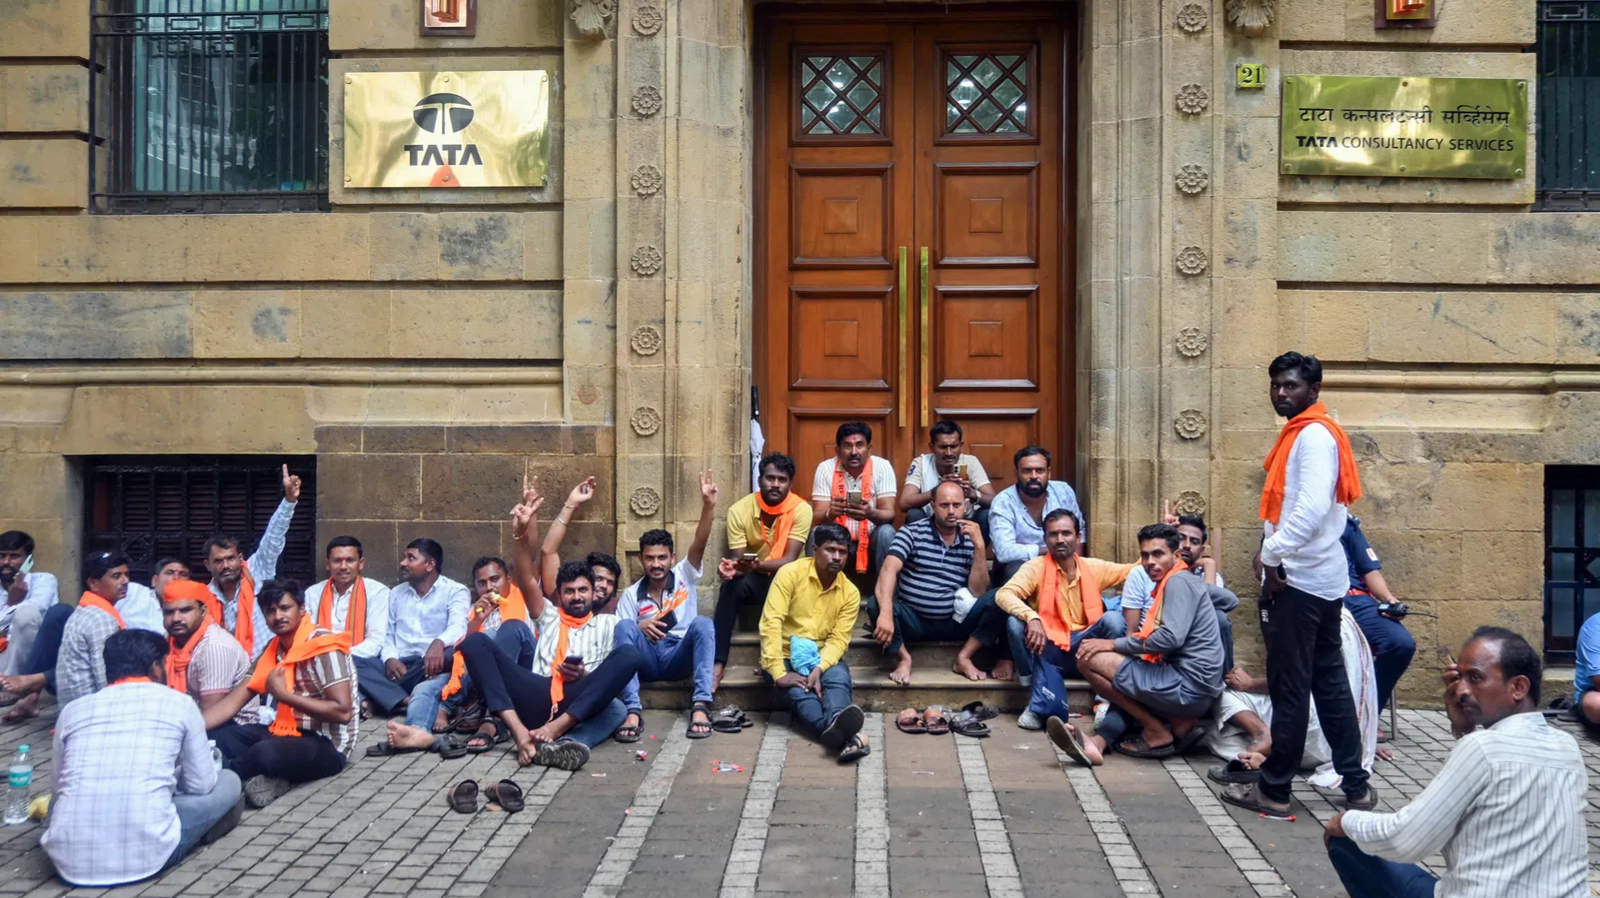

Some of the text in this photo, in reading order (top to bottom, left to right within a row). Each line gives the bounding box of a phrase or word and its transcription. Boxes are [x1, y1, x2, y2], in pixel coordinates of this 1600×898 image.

[1242, 67, 1261, 83] 21
[1299, 108, 1334, 121] टाटा
[1296, 136, 1514, 151] TATA CONSULTANCY SERVICES
[403, 144, 483, 166] TATA
